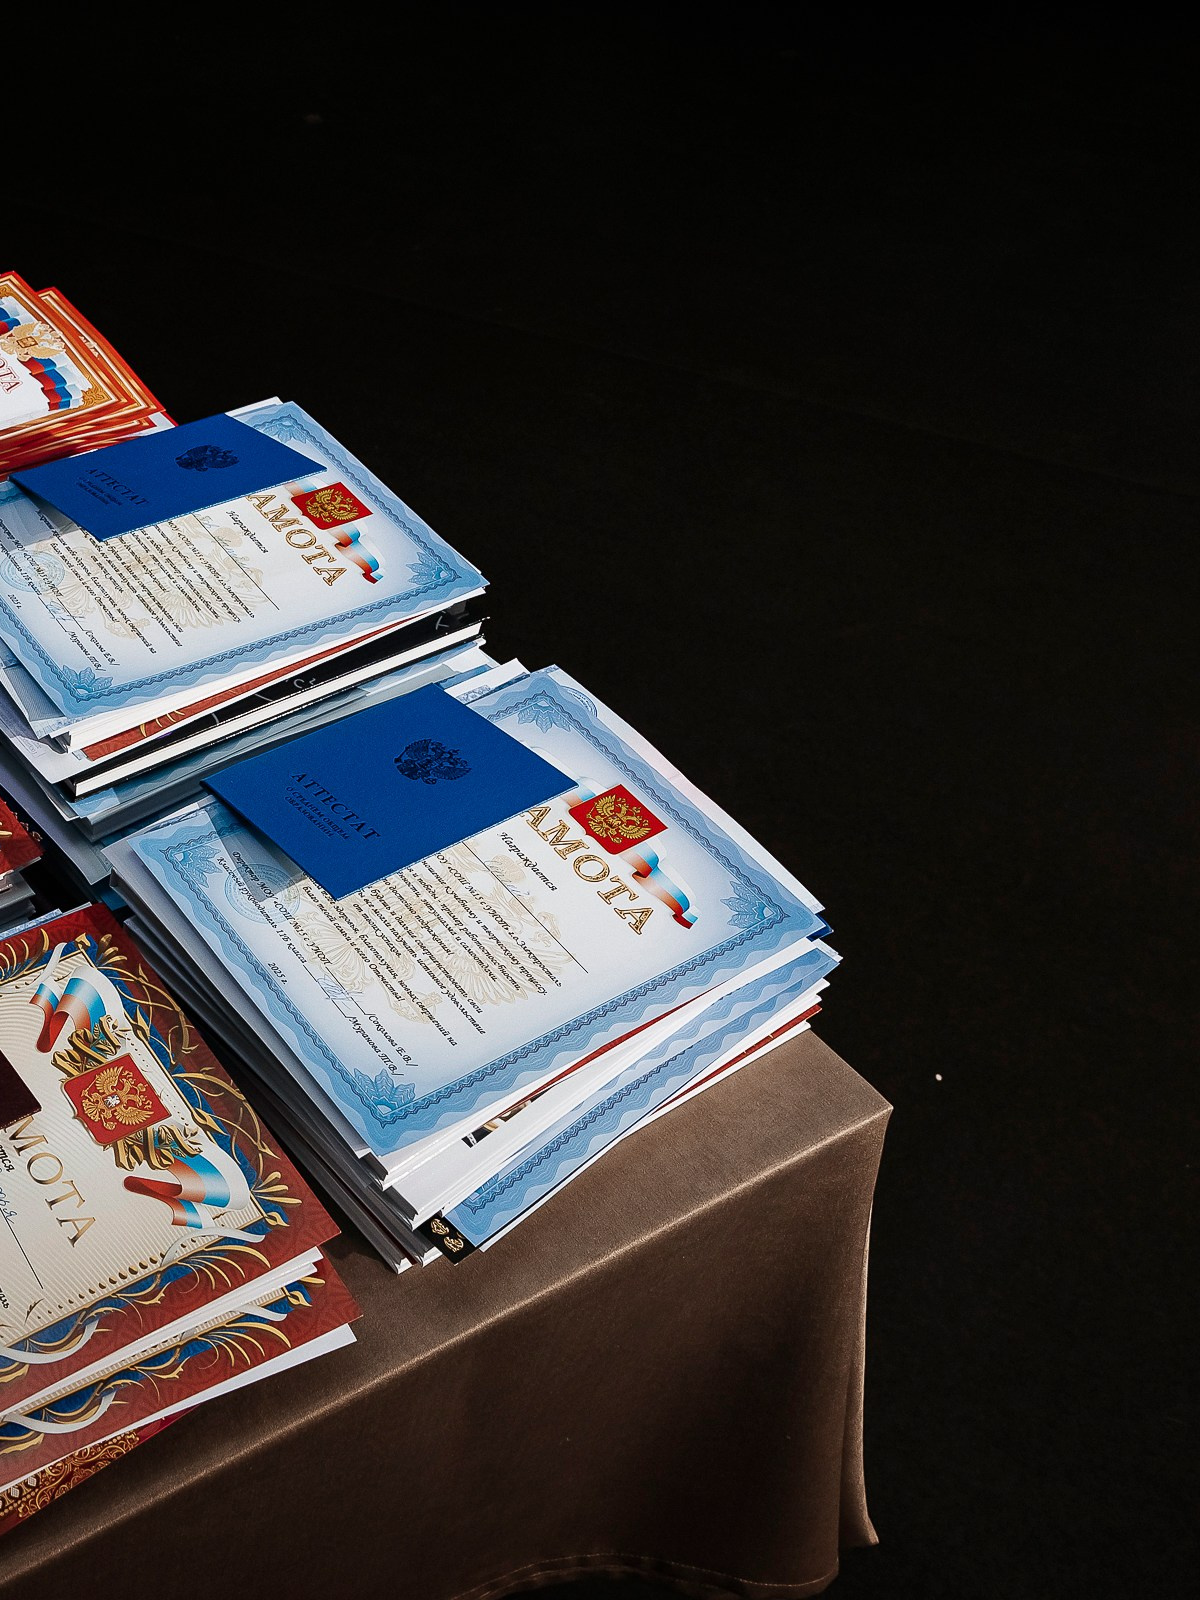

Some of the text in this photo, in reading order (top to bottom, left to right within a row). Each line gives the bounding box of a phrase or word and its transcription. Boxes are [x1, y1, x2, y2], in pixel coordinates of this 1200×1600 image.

[85, 468, 150, 506] АТТЕСТАТ
[244, 490, 347, 587] АМОТА
[291, 791, 325, 819] СРЕДНЕМ
[291, 773, 381, 840] АТТЕСТАТ
[500, 831, 558, 892] Награждается
[521, 806, 654, 935] АМОТА
[416, 877, 439, 900] победы
[440, 903, 465, 927] пример
[446, 890, 479, 920] учебному
[480, 924, 521, 966] творческому
[267, 962, 286, 979] 2025
[368, 963, 406, 1002] Отечества!
[397, 979, 419, 1003] новых
[1, 1115, 96, 1248] МОТА
